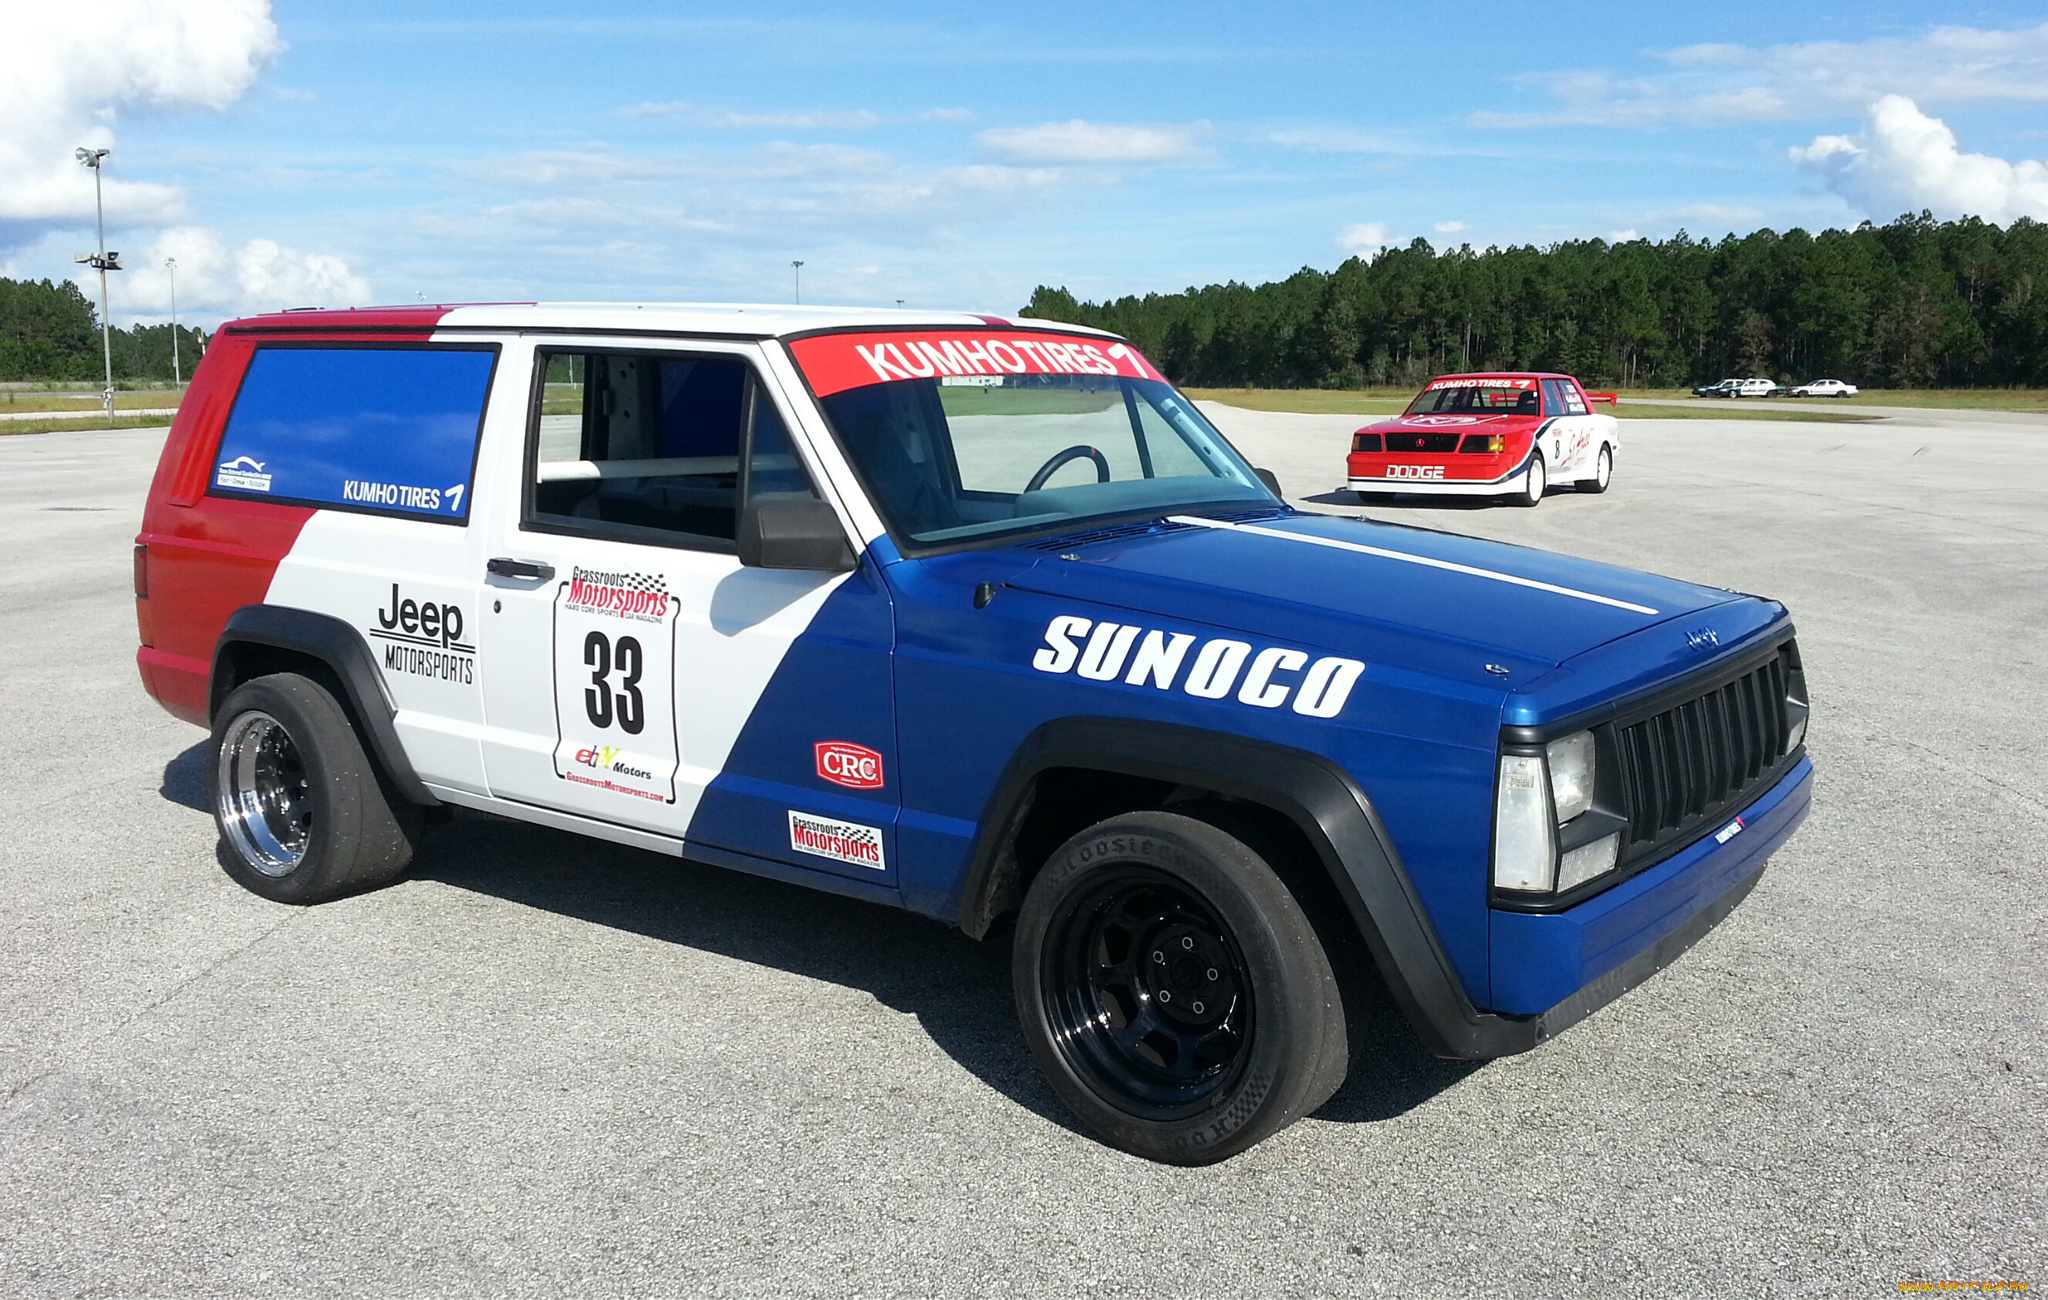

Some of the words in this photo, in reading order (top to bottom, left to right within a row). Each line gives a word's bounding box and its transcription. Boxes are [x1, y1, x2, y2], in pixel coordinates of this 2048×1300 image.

[855, 340, 1027, 382] KUMHO
[1011, 340, 1119, 376] TIRES
[1431, 380, 1476, 391] KUMHO
[1477, 380, 1511, 388] TIRES
[1555, 440, 1561, 459] 8
[1386, 465, 1445, 479] DODGE
[343, 480, 398, 505] KUMHO
[399, 486, 440, 510] TIRES
[573, 566, 625, 587] Grassroots
[567, 578, 668, 618] Motorsports
[379, 583, 463, 649] Jeep
[564, 603, 580, 612] HARD
[581, 605, 596, 615] CORE
[596, 607, 619, 618] SPORTS
[625, 612, 635, 621] CAR
[636, 614, 663, 625] MAGAZINE
[385, 644, 473, 685] MOTORSPORTS
[1032, 615, 1365, 718] SUNOCO
[584, 631, 644, 735] 33
[613, 762, 652, 780] Motors
[823, 751, 877, 781] CRC
[793, 816, 838, 837] Grassroots
[794, 826, 879, 862] Motorsports
